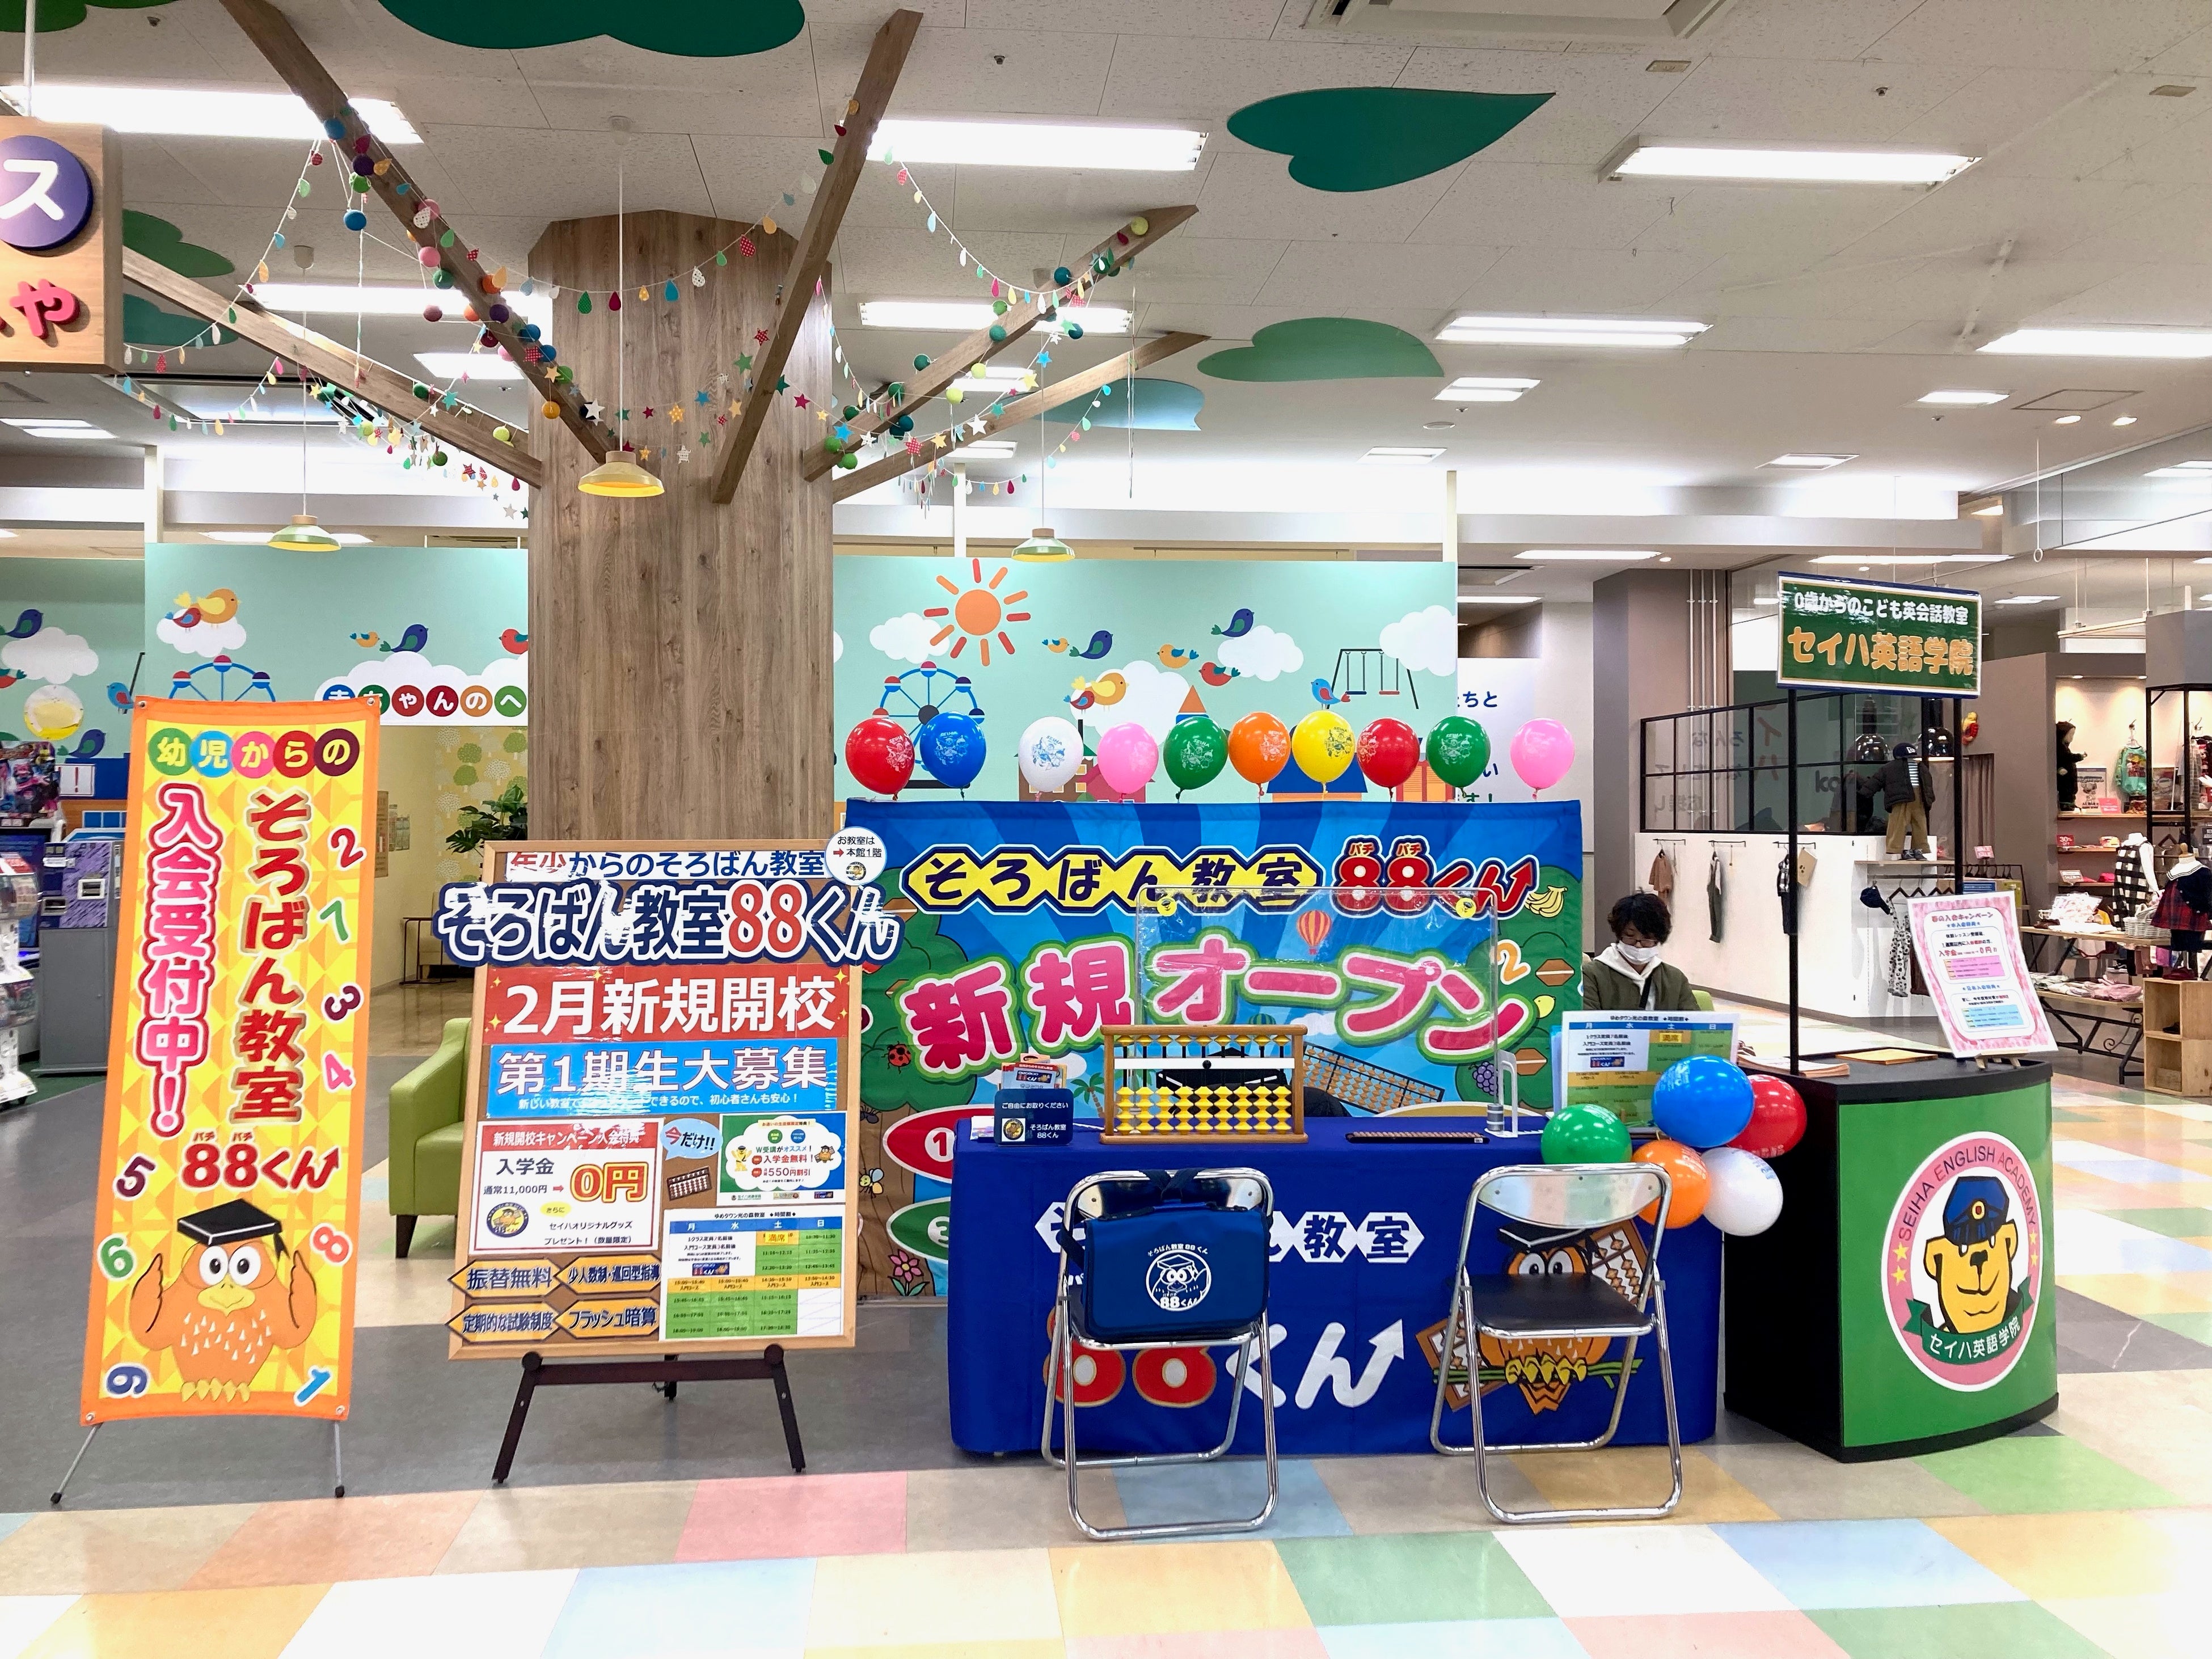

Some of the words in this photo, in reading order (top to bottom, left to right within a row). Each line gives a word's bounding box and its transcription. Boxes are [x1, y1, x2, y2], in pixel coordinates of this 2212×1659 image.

[0, 279, 80, 338] や
[1787, 626, 1973, 676] セイハ英語学院
[1458, 691, 1497, 708] ちと
[157, 737, 351, 769] 幼児からの
[1046, 735, 1062, 745] SEIHA
[1193, 739, 1210, 748] SEIHA
[331, 828, 364, 868] 2
[838, 836, 875, 845] お教室は
[846, 848, 881, 857] 本館1階
[1349, 842, 1374, 856] パチ
[1396, 842, 1421, 856] パチ
[925, 856, 1304, 906] そろばん教室
[1339, 856, 1533, 913] 88くん
[438, 884, 899, 963] そろばん教室88くん
[145, 791, 218, 1128] 入会受付中!
[233, 793, 309, 1120] そろばん教室
[1497, 943, 1527, 982] 2
[325, 986, 361, 1021] 3
[503, 978, 835, 1036] 2月新規開校
[904, 937, 1526, 1070] 新規オープン
[324, 1054, 353, 1089] 4
[496, 1046, 828, 1095] 第1期生大募集
[493, 1130, 640, 1146] 新規開校キャンペーン入会特典
[665, 1126, 715, 1151] 今だけ!!
[932, 1132, 947, 1156] 1
[117, 1156, 155, 1197] 5
[183, 1144, 339, 1188] 88くん
[496, 1158, 555, 1176] 入学金
[763, 1155, 813, 1163] 入学金無料!
[769, 1168, 810, 1176] 550円割引
[483, 1185, 547, 1195] 通常11,000円
[571, 1162, 647, 1202] 0円
[1898, 1181, 1935, 1242] SEIHA
[1935, 1146, 1995, 1182] ENGLISH
[1996, 1153, 2036, 1226] ACADEMY
[549, 1221, 632, 1230] セイハオリジナルグッズ
[100, 1238, 133, 1278] 6
[314, 1227, 349, 1262] 8
[467, 1267, 553, 1290] 振替無料
[463, 1313, 553, 1333] 定期的な試験制度
[569, 1307, 656, 1328] フラッシュ暗算
[1930, 1316, 2021, 1360] セイハ英語学院
